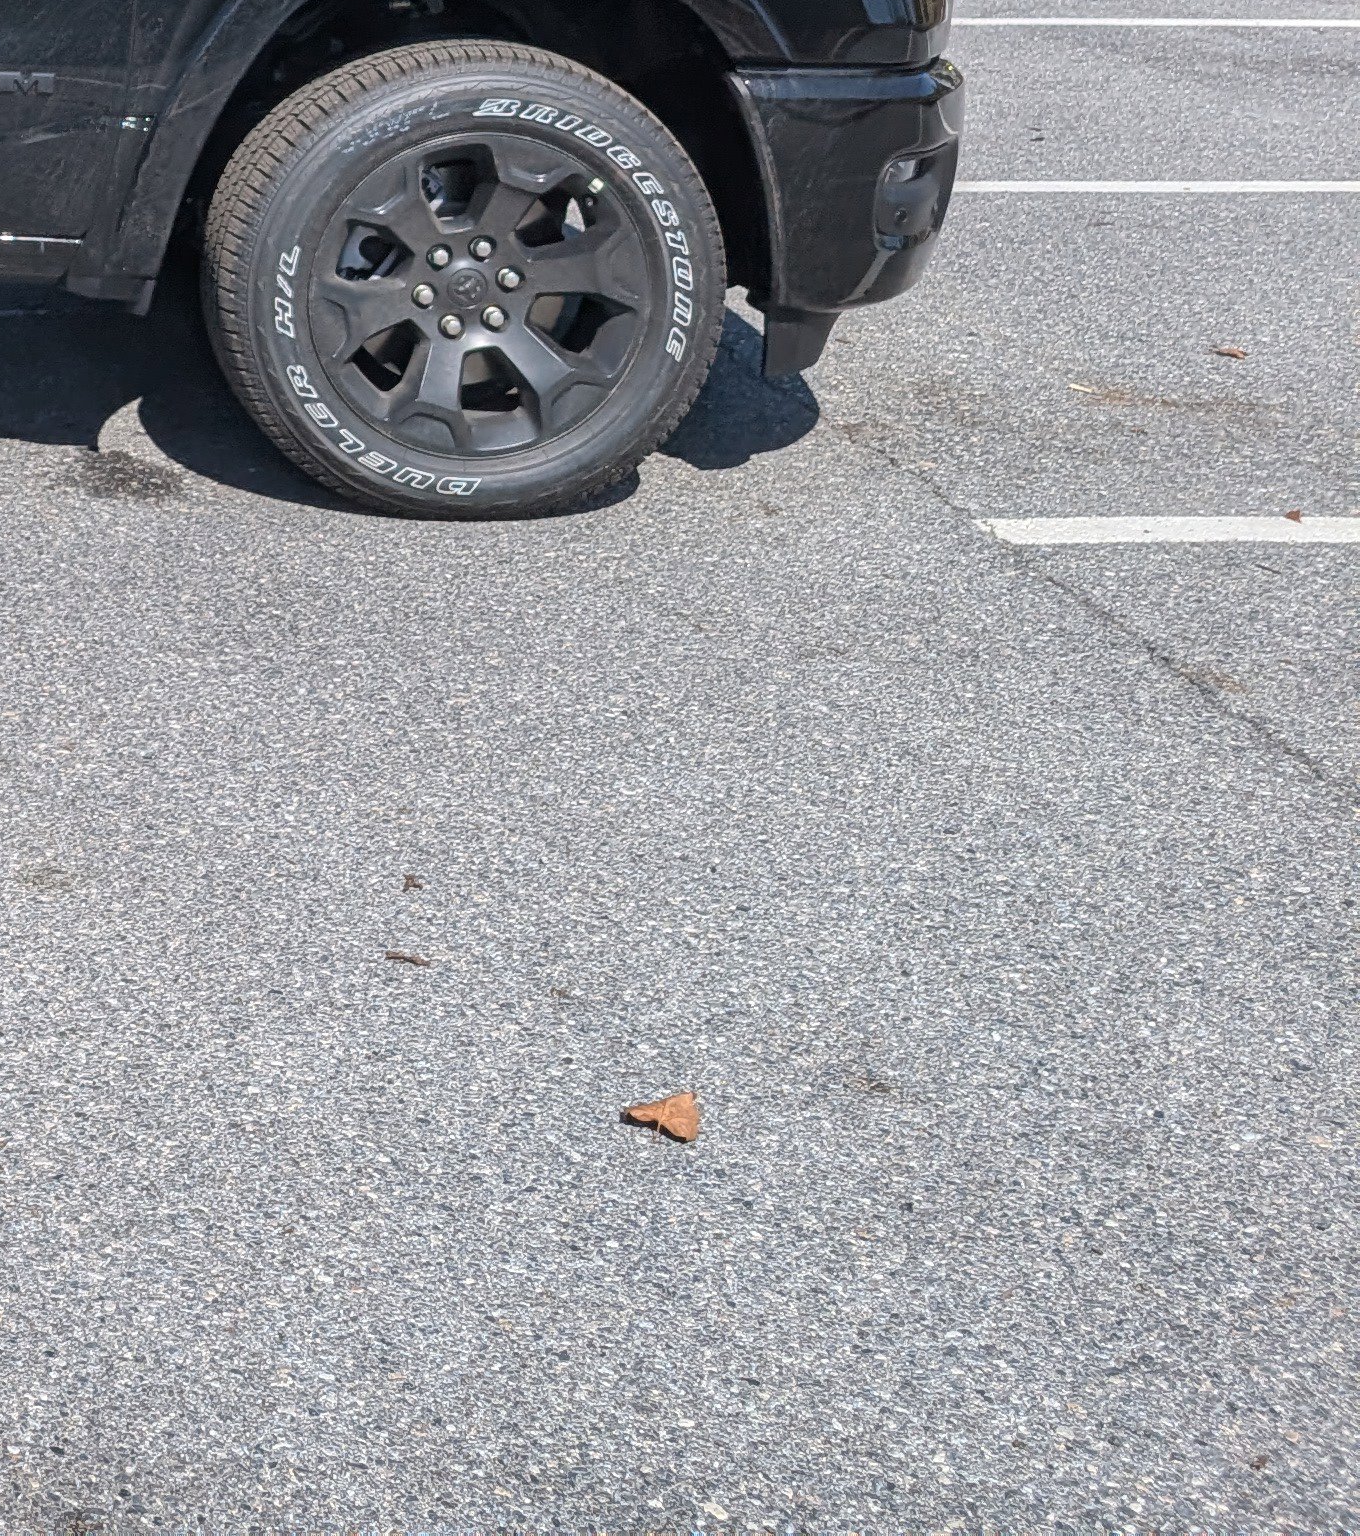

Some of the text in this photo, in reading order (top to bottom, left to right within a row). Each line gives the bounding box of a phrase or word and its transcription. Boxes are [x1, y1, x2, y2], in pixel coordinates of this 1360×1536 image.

[473, 98, 696, 363] BRIDGESTONE
[275, 244, 483, 497] DUELER H/L
